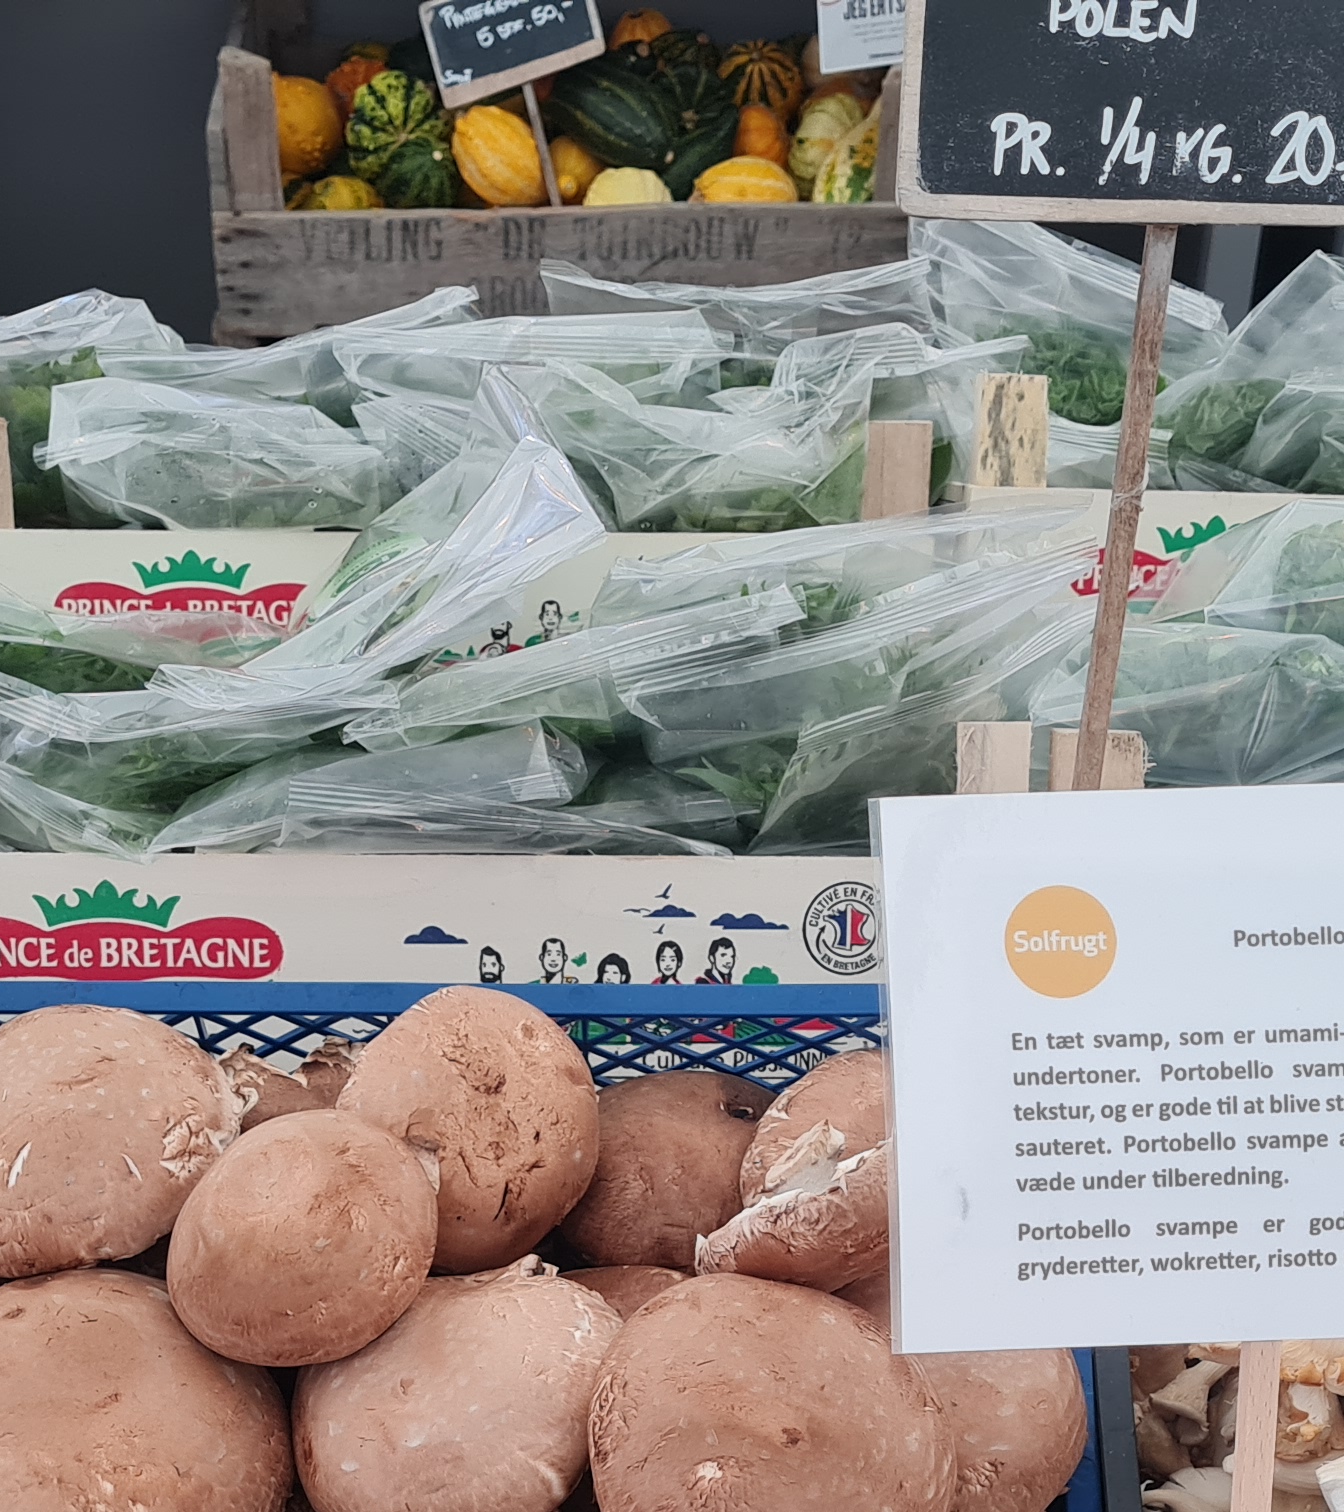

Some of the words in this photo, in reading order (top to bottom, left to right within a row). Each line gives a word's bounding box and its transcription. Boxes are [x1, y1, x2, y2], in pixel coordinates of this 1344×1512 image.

[1097, 96, 1157, 187] 1/4
[808, 888, 841, 928] CULTIVÉ
[843, 887, 858, 897] EN
[63, 939, 94, 968] de
[99, 937, 272, 969] BRETAGNE
[1013, 929, 1108, 958] Solfrugt
[821, 953, 834, 966] EN
[833, 952, 877, 971] BRETAGNE
[1011, 1032, 1038, 1052] En
[1045, 1031, 1085, 1050] tæt
[1093, 1032, 1171, 1052] svamp,
[1179, 1030, 1224, 1047] som
[1233, 1029, 1256, 1045] er
[1012, 1065, 1141, 1087] undertoner.
[1160, 1059, 1274, 1083] Portobello
[1012, 1100, 1096, 1124] tekstur,
[1100, 1103, 1128, 1124] og
[1131, 1102, 1155, 1118] er
[1158, 1096, 1212, 1122] gode
[1215, 1094, 1238, 1116] til
[1243, 1096, 1265, 1115] at
[1269, 1093, 1321, 1114] blive
[1014, 1136, 1113, 1158] sauteret.
[1123, 1130, 1237, 1155] Portobello
[1246, 1133, 1329, 1153] svampe
[1015, 1170, 1076, 1193] væde
[1082, 1168, 1147, 1191] under
[1151, 1165, 1290, 1190] tilberedning.
[1017, 1218, 1132, 1242] Portobello
[1155, 1219, 1239, 1240] svampe
[1262, 1218, 1286, 1234] er
[1017, 1255, 1145, 1282] gryderetter,
[1149, 1251, 1261, 1273] wokretter,
[1267, 1248, 1338, 1269] risotto
